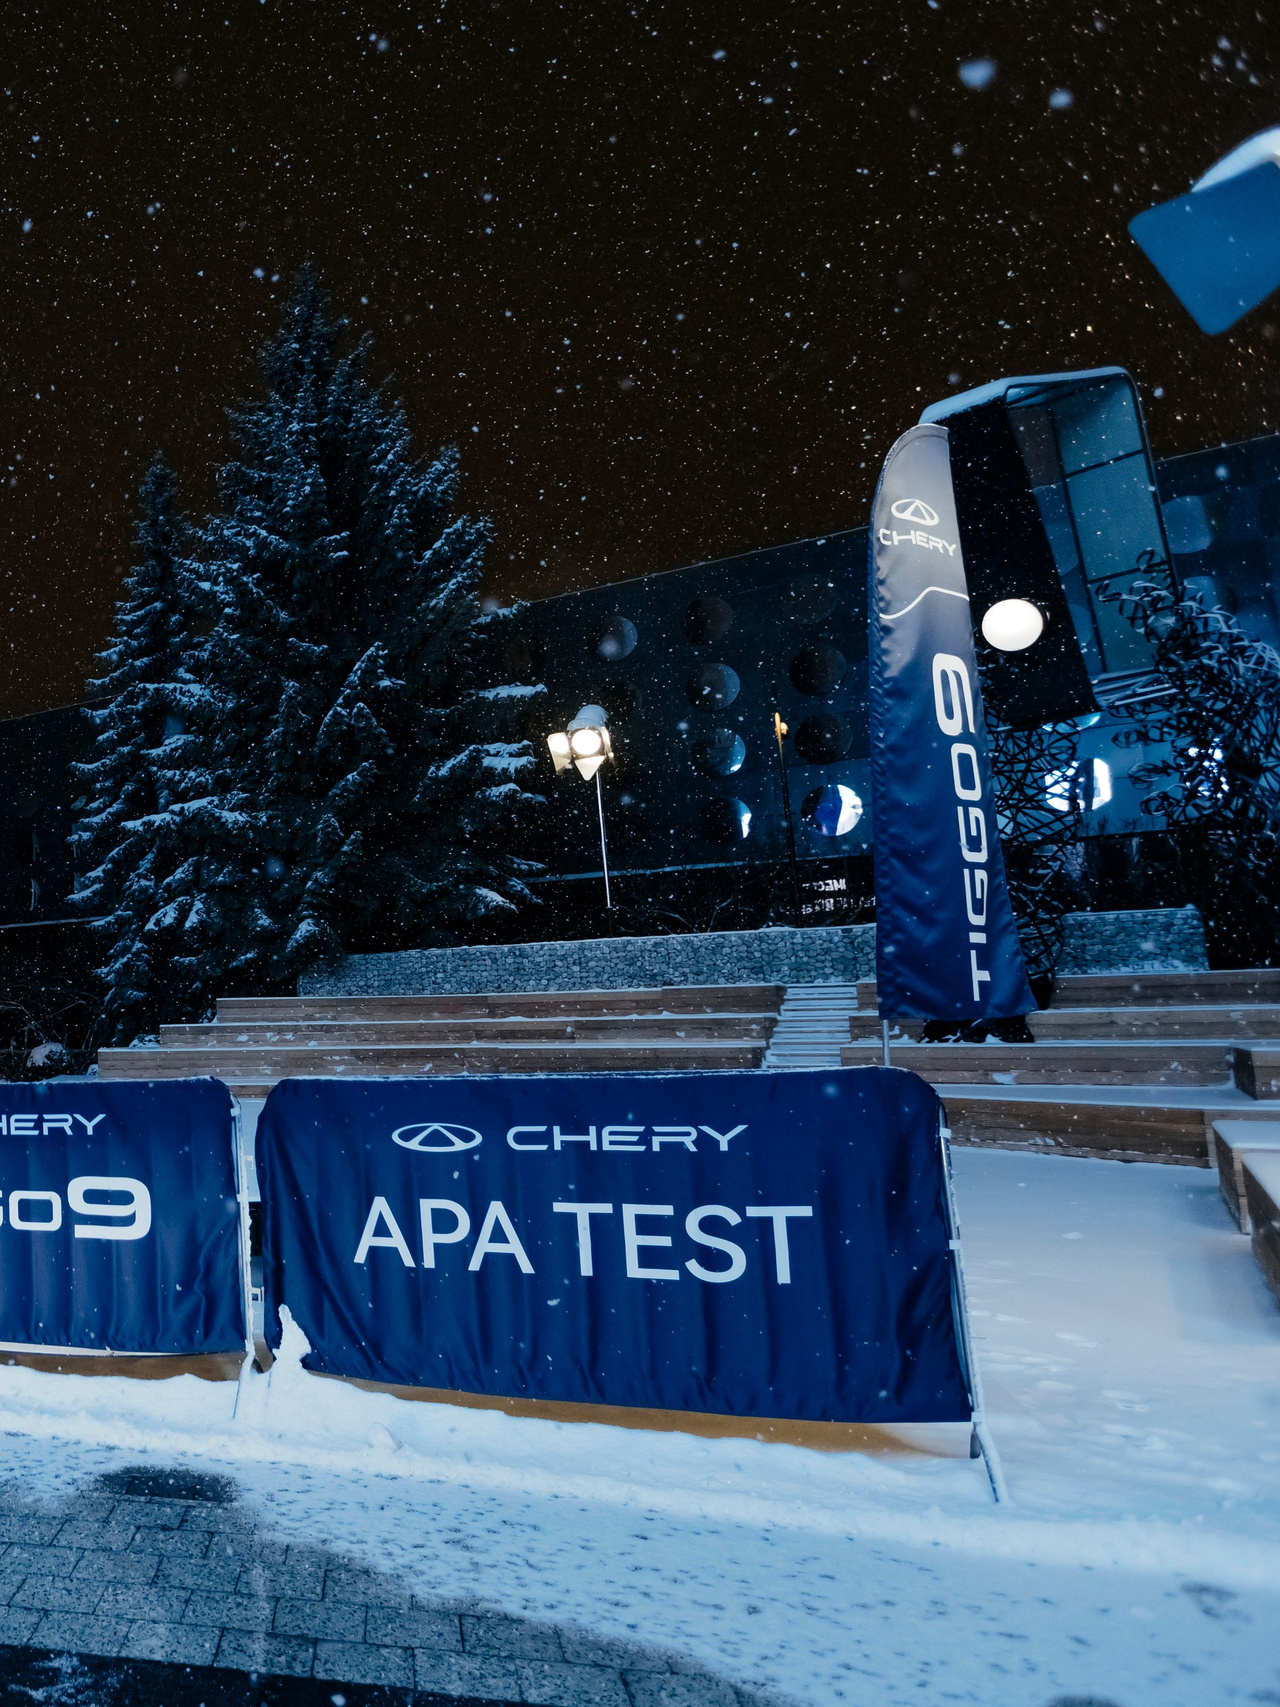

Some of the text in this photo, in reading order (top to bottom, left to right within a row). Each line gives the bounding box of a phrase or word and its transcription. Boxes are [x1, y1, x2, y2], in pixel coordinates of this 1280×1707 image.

[879, 528, 957, 557] CHERY
[506, 1125, 748, 1152] CHERY
[353, 1196, 813, 1284] APA TEST
